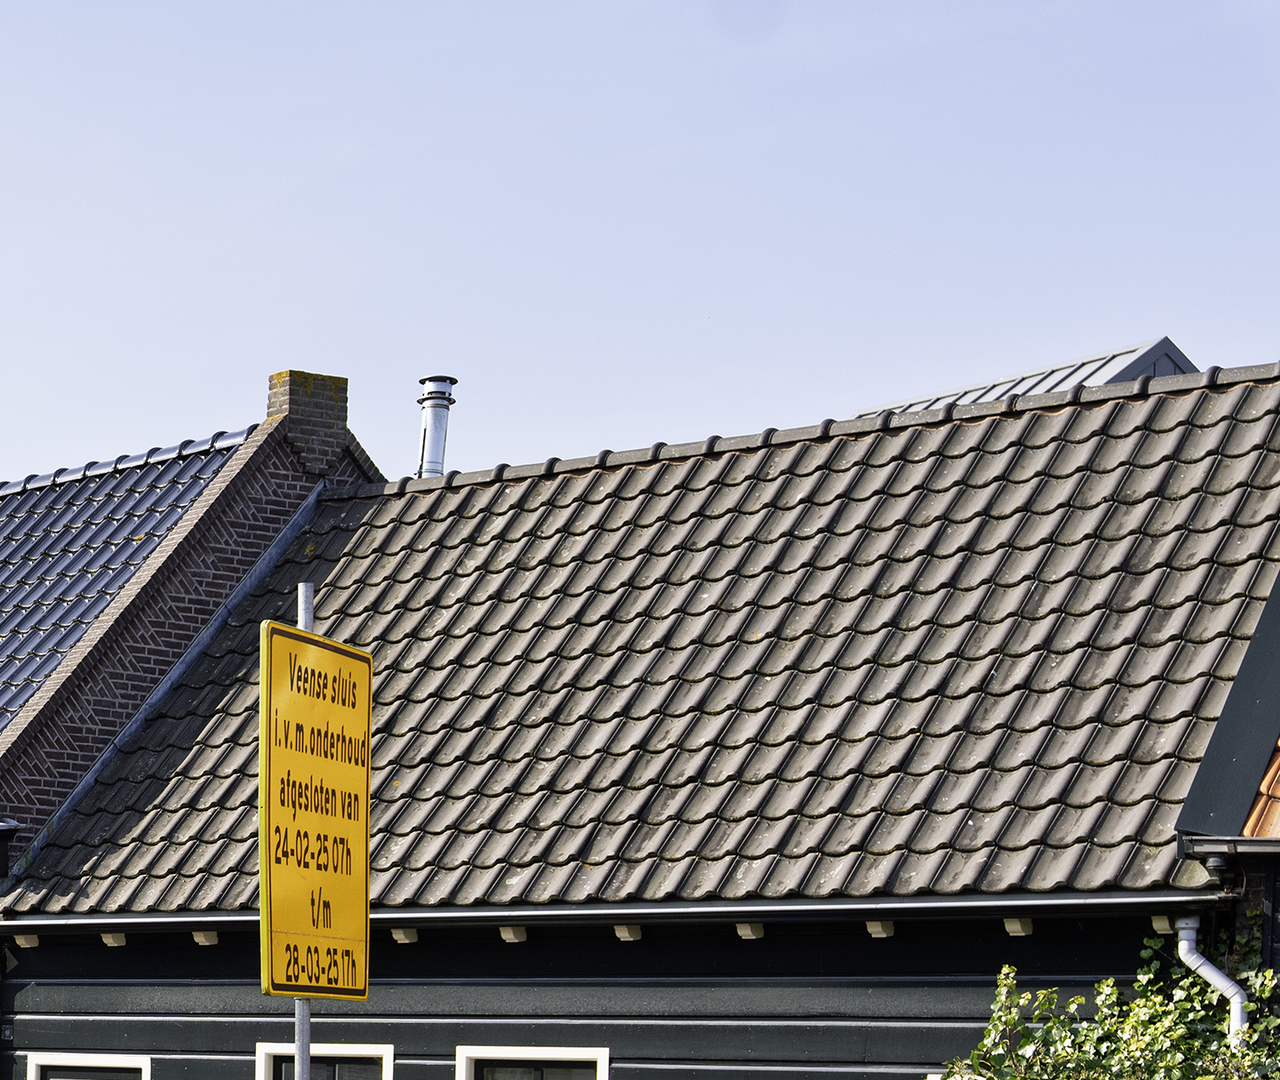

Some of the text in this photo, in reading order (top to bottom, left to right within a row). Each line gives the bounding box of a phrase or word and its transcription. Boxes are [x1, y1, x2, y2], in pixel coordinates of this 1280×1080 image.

[289, 652, 357, 709] Veense sluis
[280, 770, 359, 822] afgesloten van
[275, 825, 351, 876] 24-02-25 07h
[310, 887, 332, 930] t/m
[285, 943, 357, 987] 28-03-25 17h
